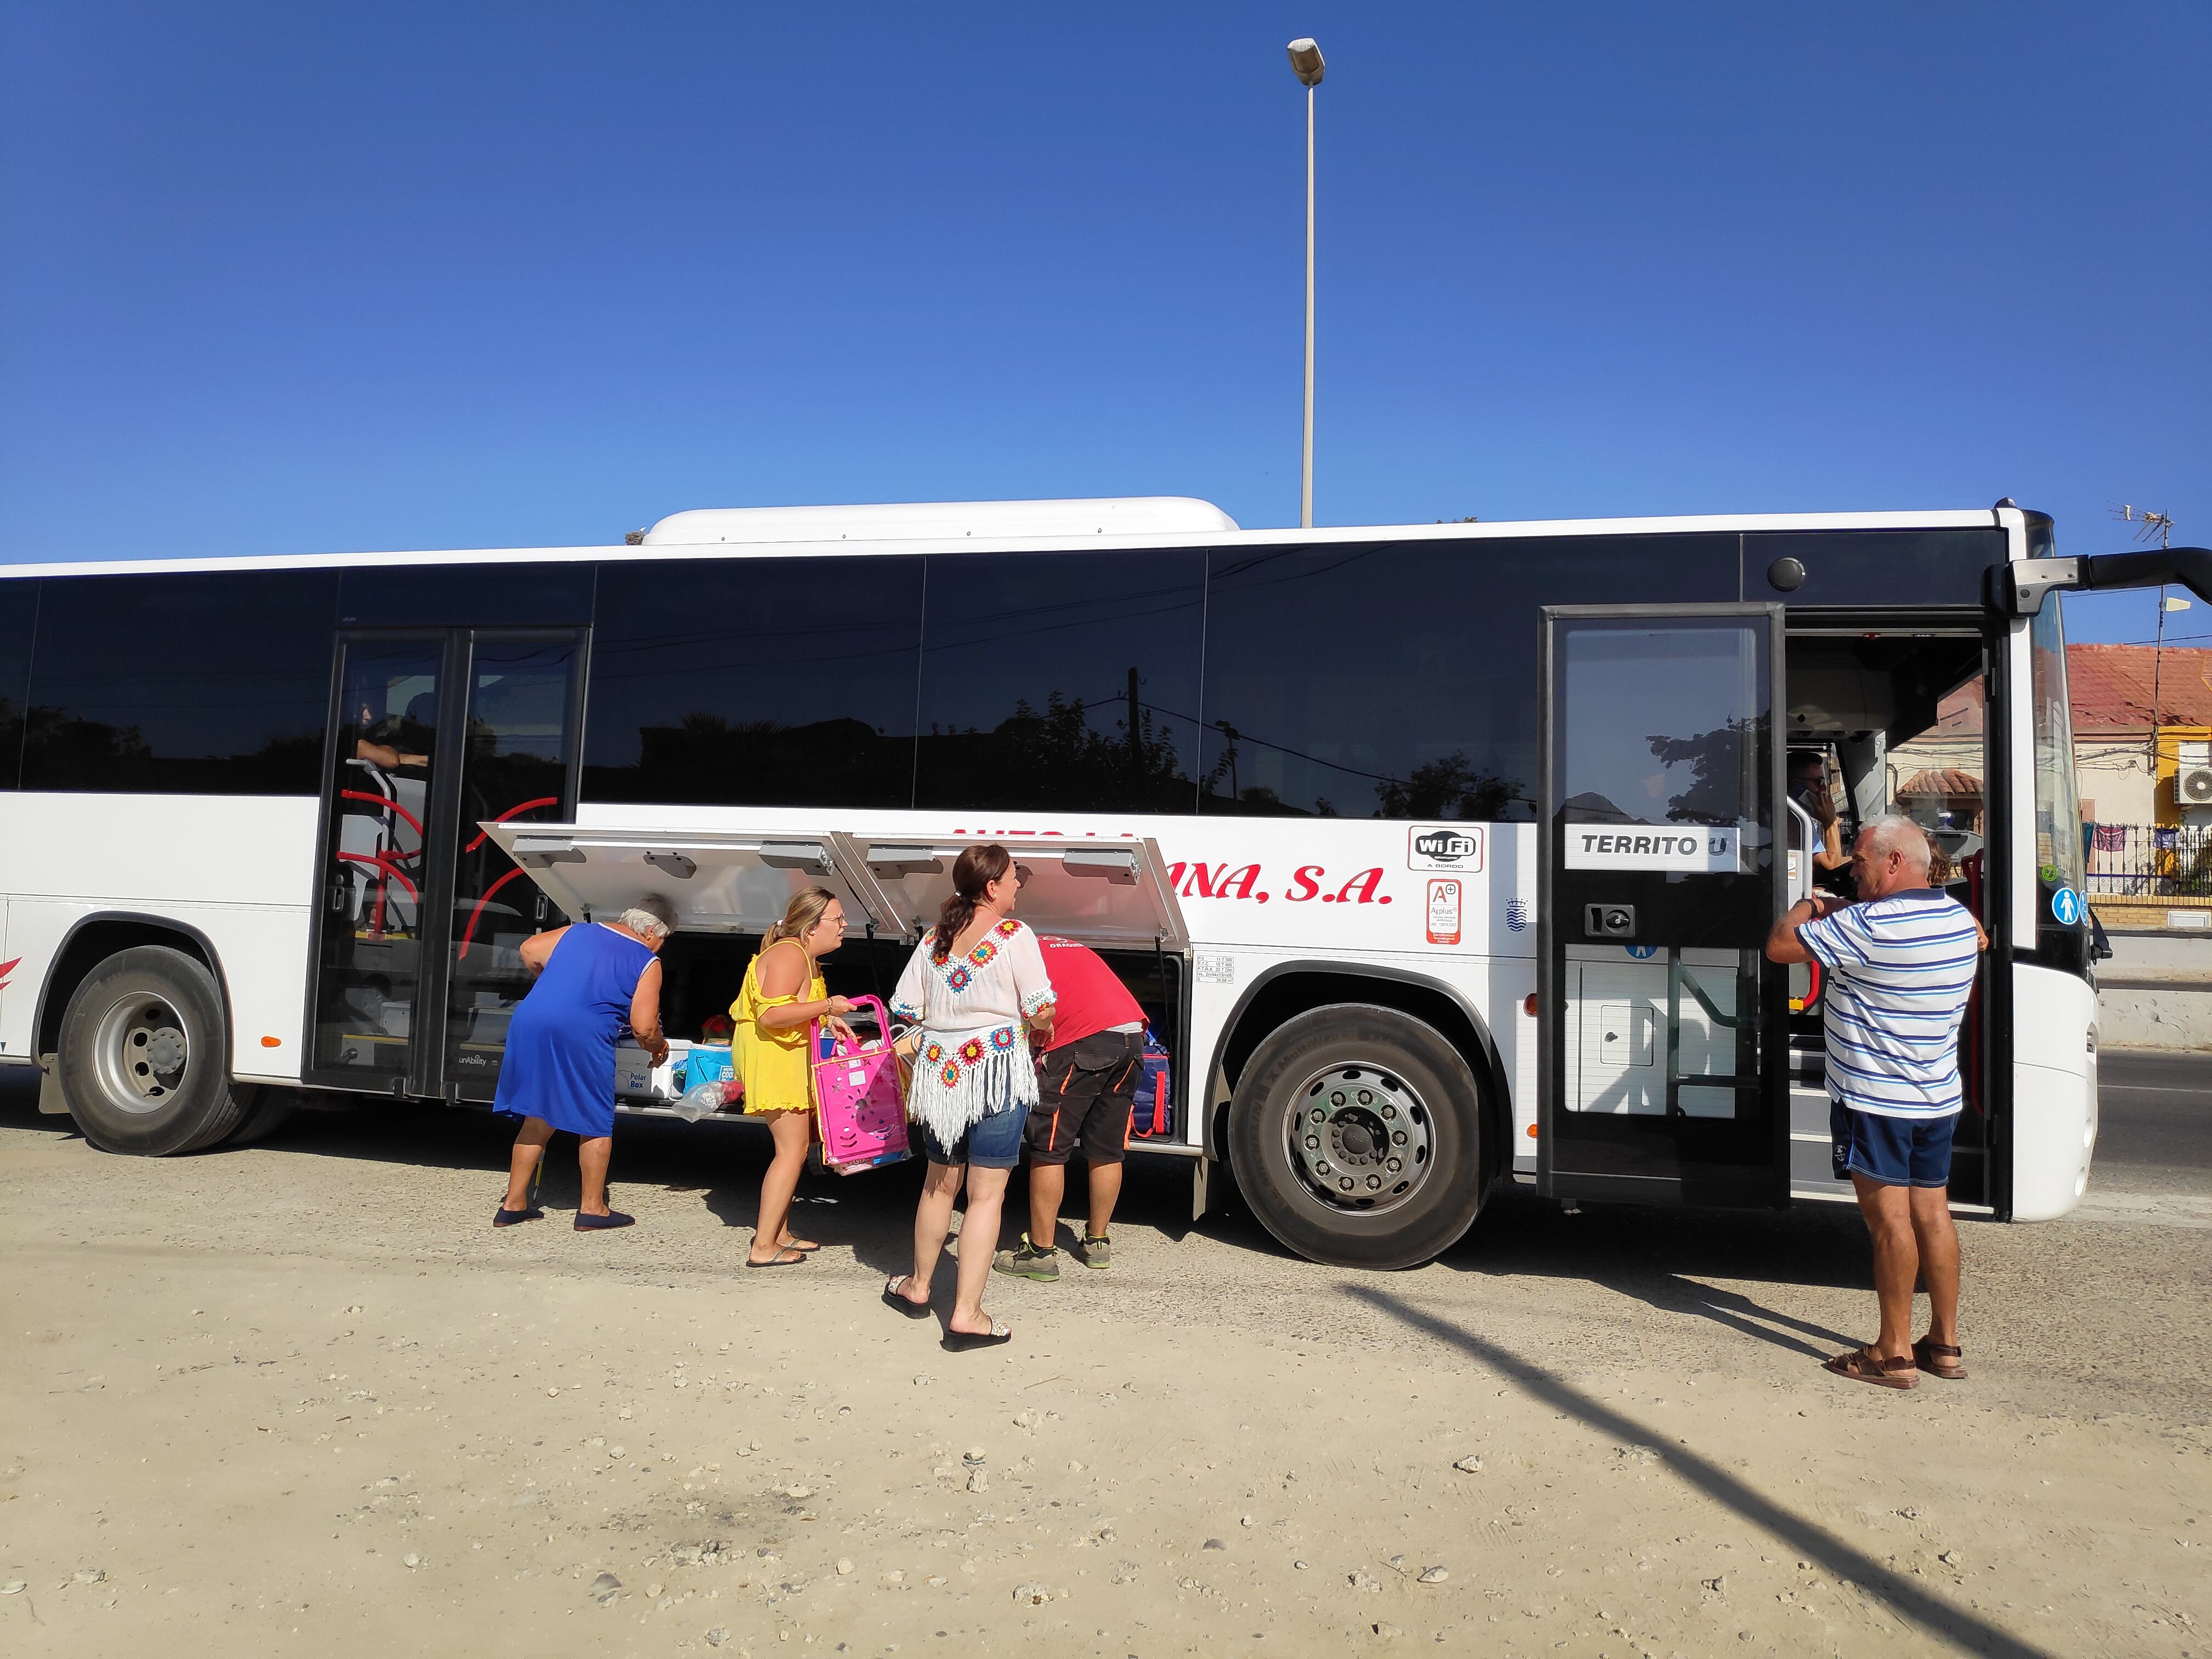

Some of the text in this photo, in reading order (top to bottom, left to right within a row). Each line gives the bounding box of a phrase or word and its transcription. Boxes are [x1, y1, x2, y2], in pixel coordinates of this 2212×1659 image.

[1581, 834, 1728, 856] TERRITO U
[1285, 865, 1392, 905] S.A.
[630, 1073, 647, 1081] Polar
